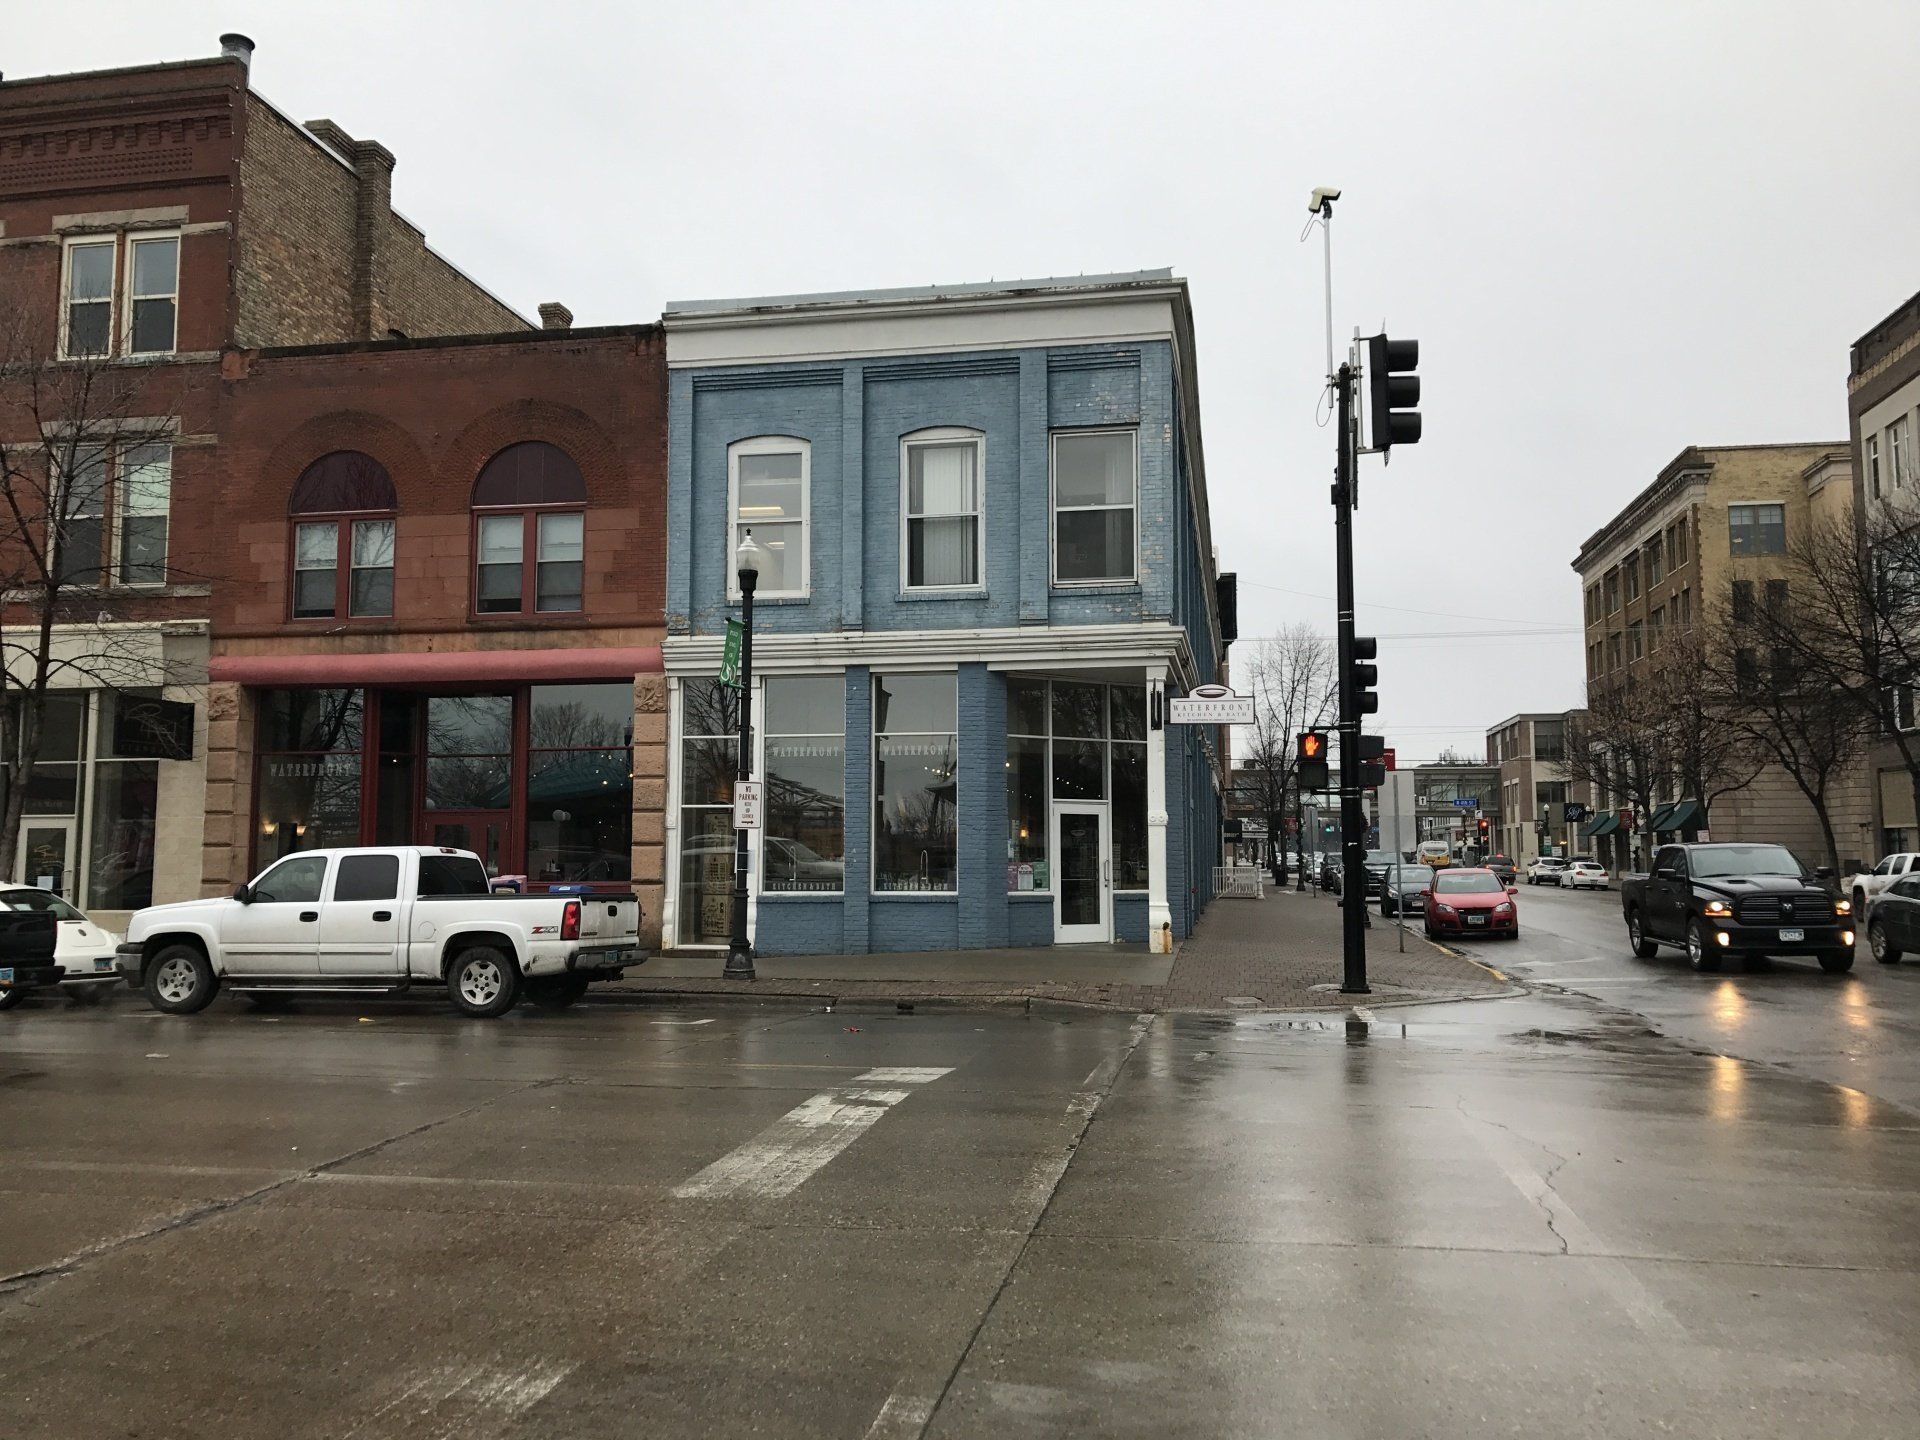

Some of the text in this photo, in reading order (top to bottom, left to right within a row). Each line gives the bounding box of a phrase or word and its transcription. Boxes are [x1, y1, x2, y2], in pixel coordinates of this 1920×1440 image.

[1173, 703, 1251, 712] WATERFRONT
[773, 746, 839, 757] WATERFRONT
[883, 744, 949, 756] WATERFRONT
[270, 763, 351, 777] WATERFRONT
[745, 785, 752, 793] NO
[738, 793, 758, 801] PARKING
[772, 882, 807, 890] KITCHEN
